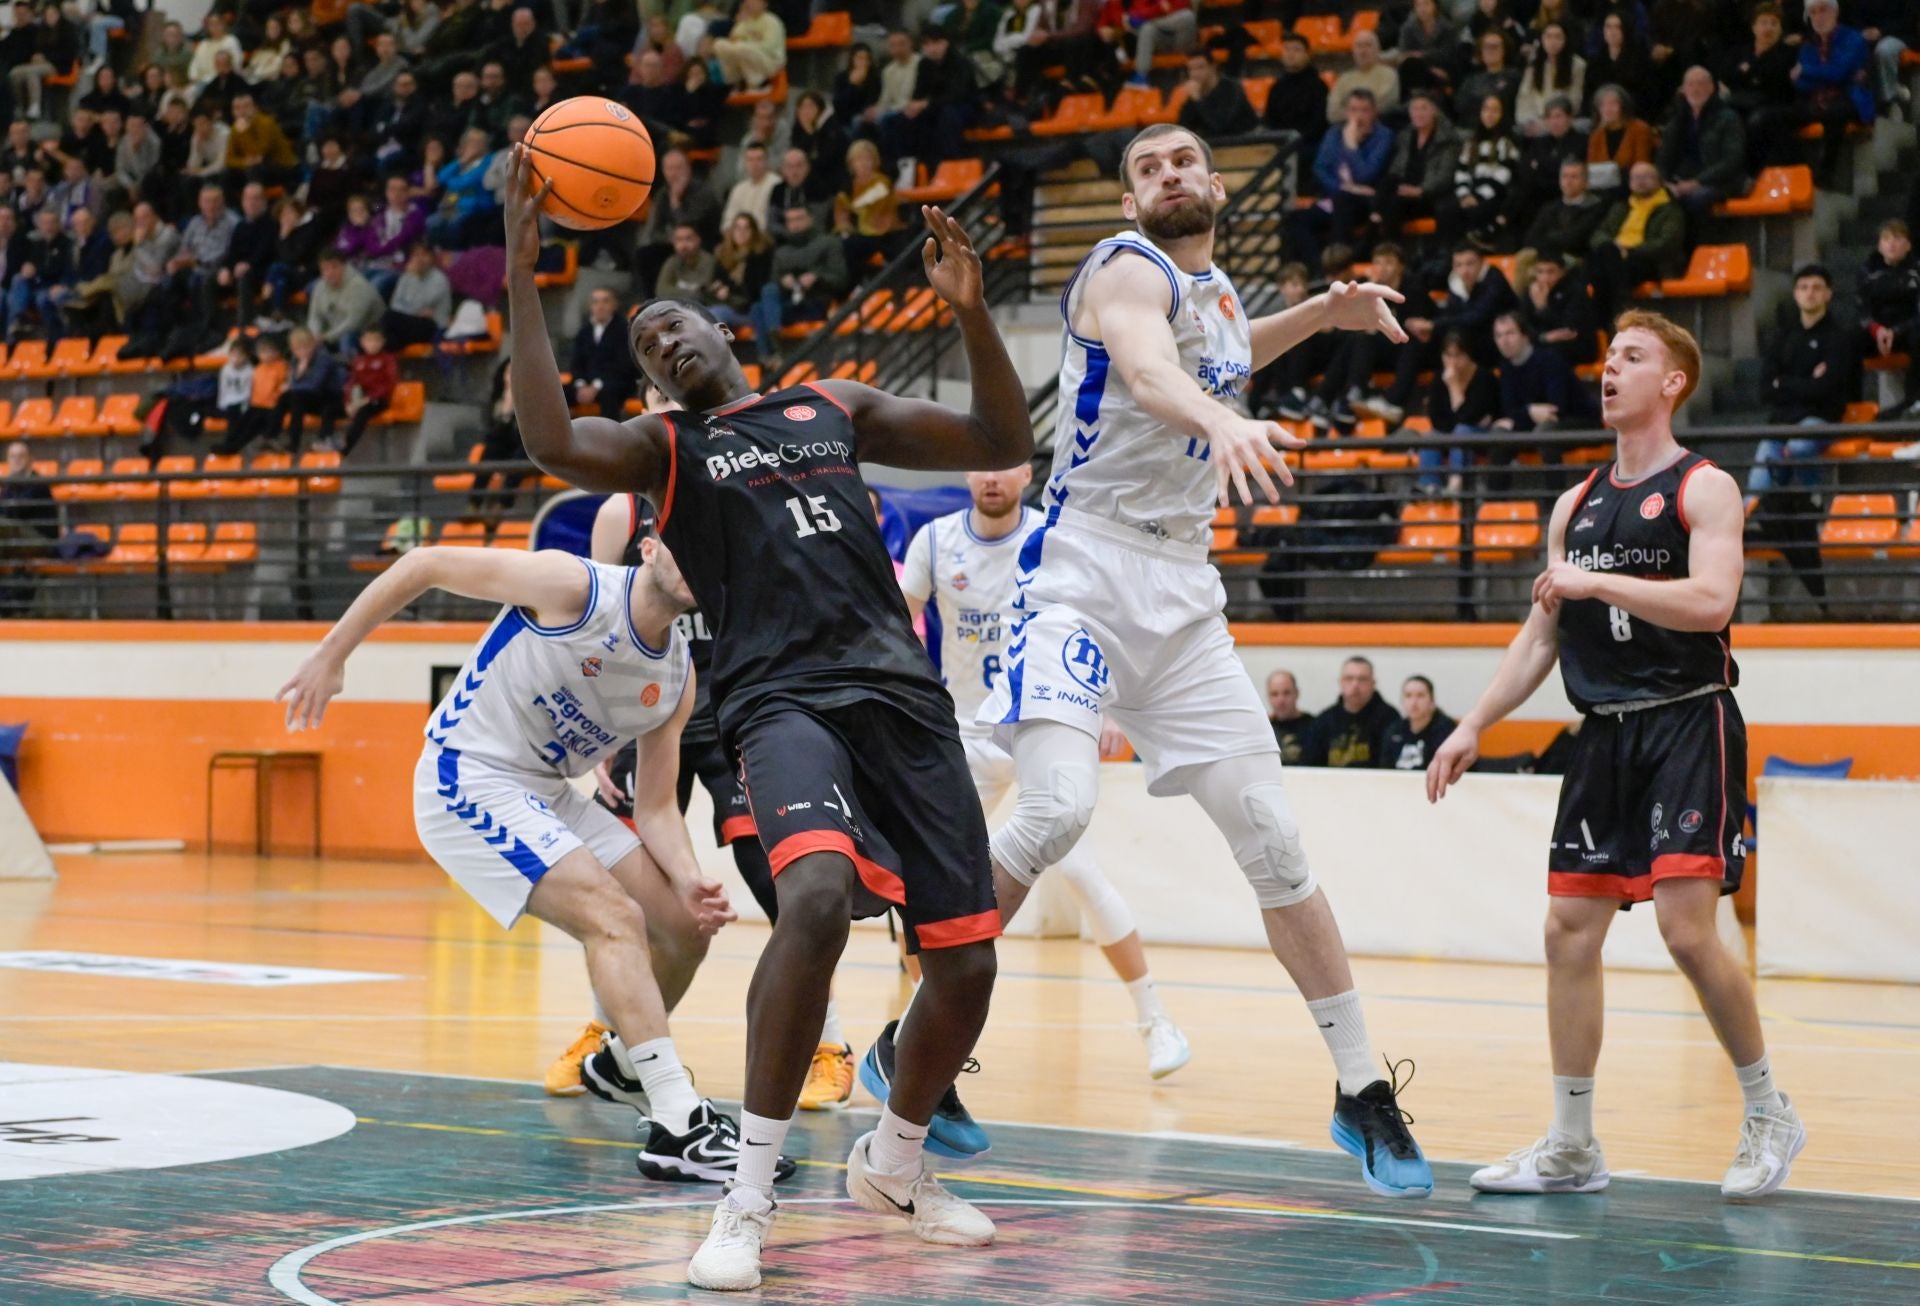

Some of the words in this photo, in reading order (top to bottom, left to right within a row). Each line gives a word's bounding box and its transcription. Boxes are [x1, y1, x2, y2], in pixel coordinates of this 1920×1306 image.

[706, 440, 849, 481] BieleGroup
[747, 470, 785, 488] PASSIO
[786, 494, 842, 538] 15
[1609, 605, 1632, 642] 8
[983, 655, 1003, 690] 8
[551, 691, 618, 746] agropal
[787, 801, 812, 811] WIBO
